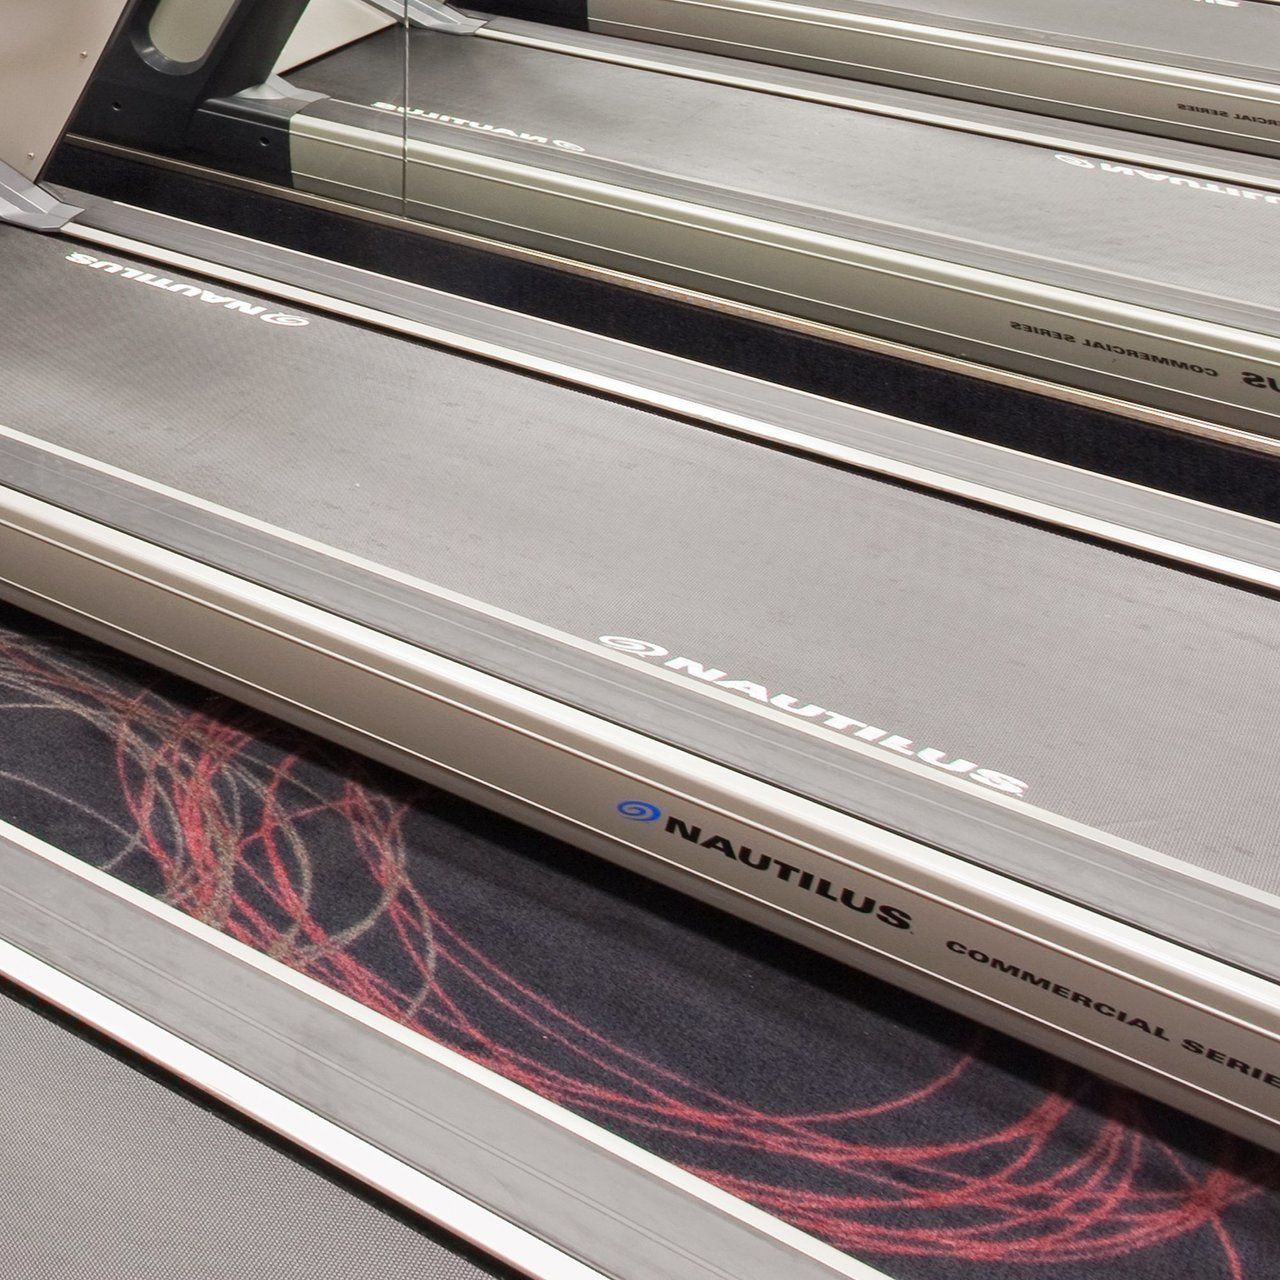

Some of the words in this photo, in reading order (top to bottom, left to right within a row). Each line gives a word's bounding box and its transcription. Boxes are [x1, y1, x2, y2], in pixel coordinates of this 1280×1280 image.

[65, 251, 269, 317] NAUTILUS
[664, 655, 1029, 797] NAUTILUS
[665, 814, 914, 934] NAUTILUS
[945, 939, 1171, 1043] COMMERCIAL
[1181, 1038, 1280, 1089] SERIE
